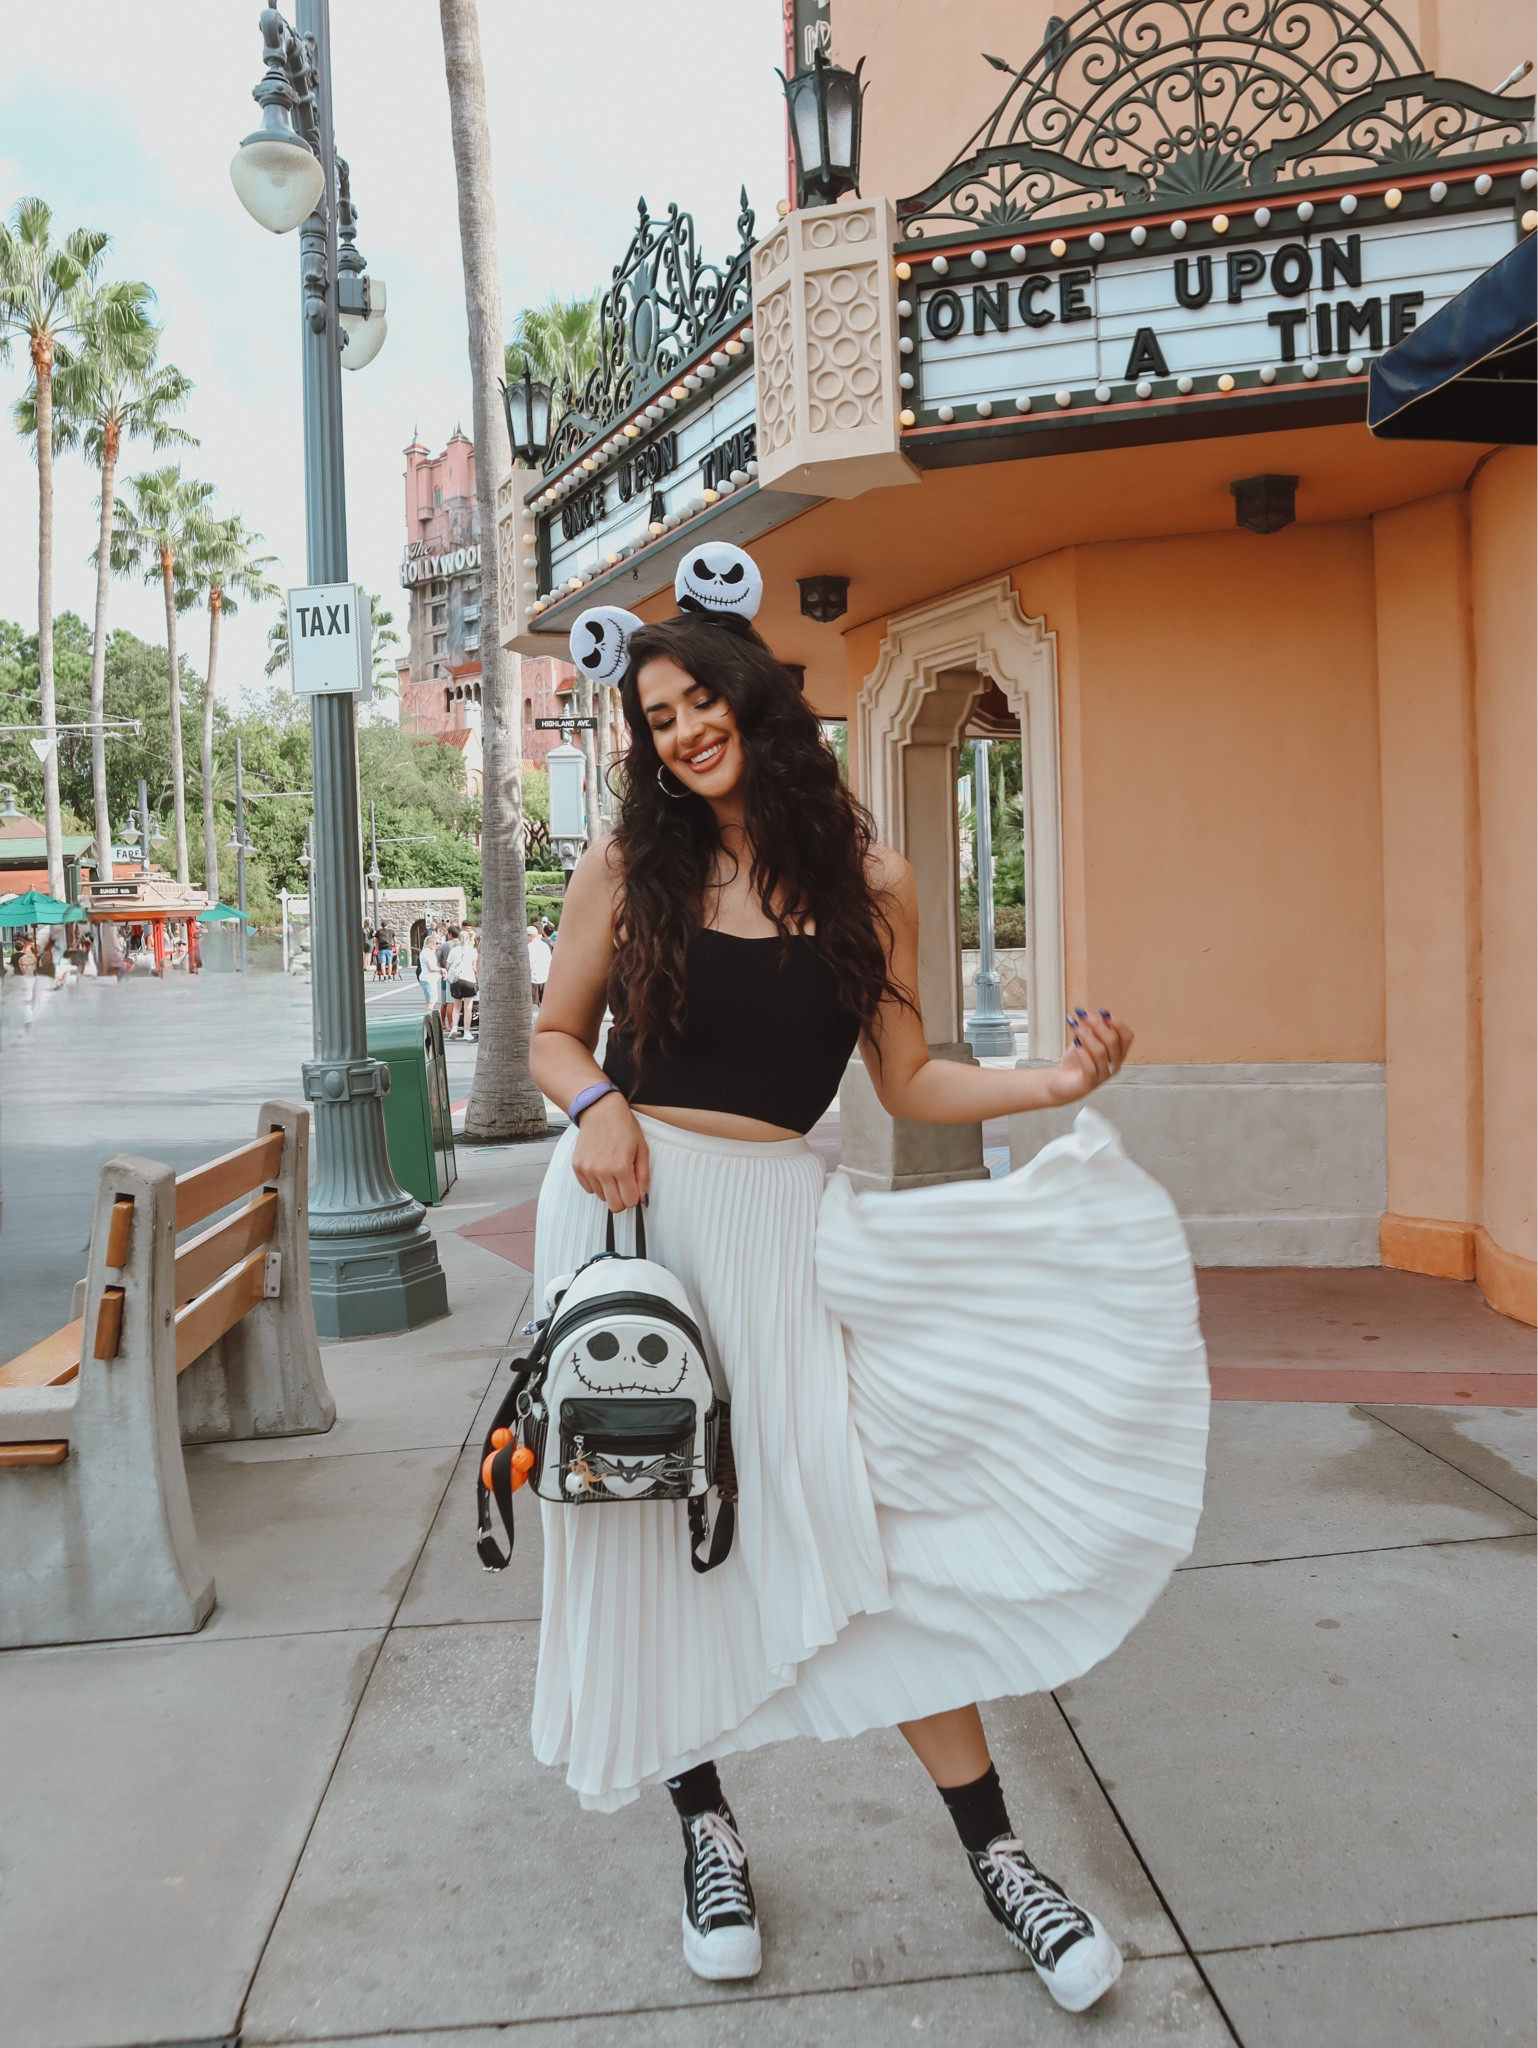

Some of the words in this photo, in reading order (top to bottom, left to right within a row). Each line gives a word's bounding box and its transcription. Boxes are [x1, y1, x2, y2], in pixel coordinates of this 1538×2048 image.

[926, 269, 1092, 341] ONCE
[1174, 234, 1362, 310] UPON
[1124, 327, 1170, 380] A
[1268, 291, 1424, 362] TIME
[562, 482, 606, 540] ONCE
[618, 430, 678, 503] UPON
[649, 490, 665, 525] A
[699, 423, 757, 489] TIME
[399, 543, 481, 585] HOLLYWOO
[409, 540, 432, 559] The
[296, 604, 350, 637] TAXI
[541, 719, 575, 727] HIGHLAND
